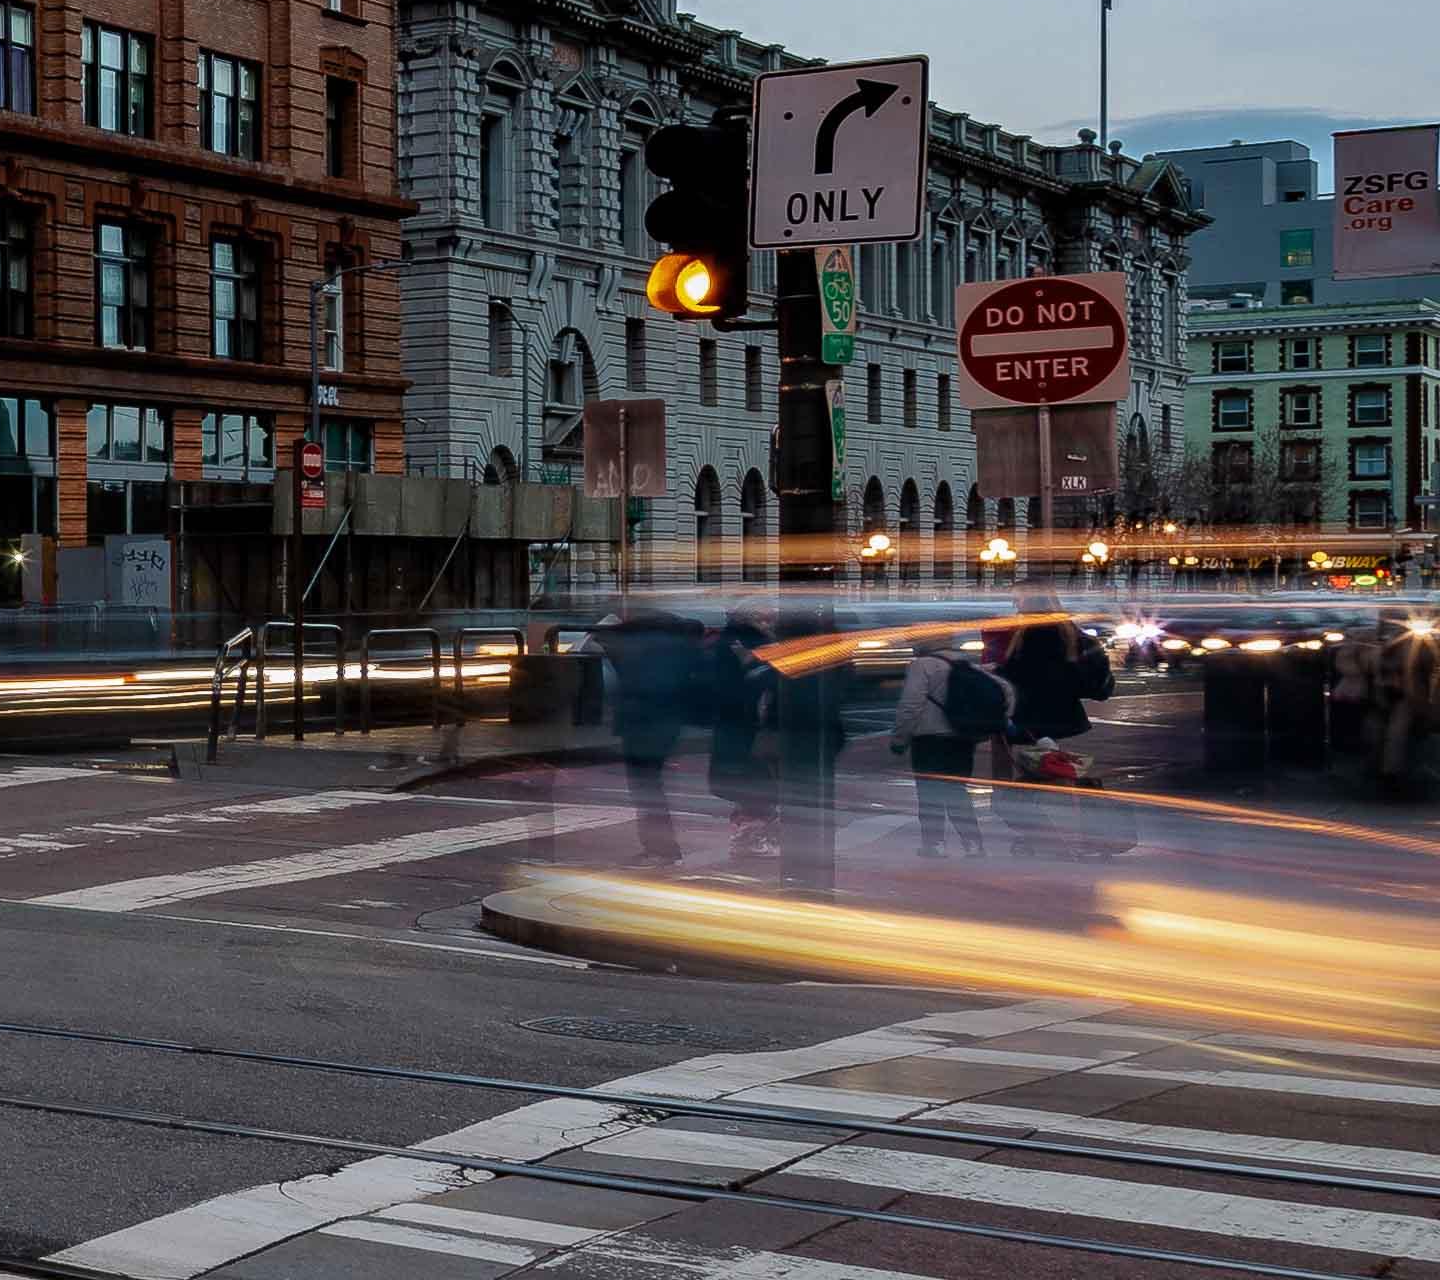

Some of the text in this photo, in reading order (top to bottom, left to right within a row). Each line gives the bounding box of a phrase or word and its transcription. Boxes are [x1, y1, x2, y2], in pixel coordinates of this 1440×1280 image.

[1343, 170, 1429, 195] ZSFG
[786, 186, 885, 225] ONLY
[1343, 196, 1414, 215] Care
[1343, 216, 1393, 232] .org
[832, 301, 850, 323] 50
[985, 301, 1096, 328] DO NOT
[995, 357, 1090, 382] ENTER
